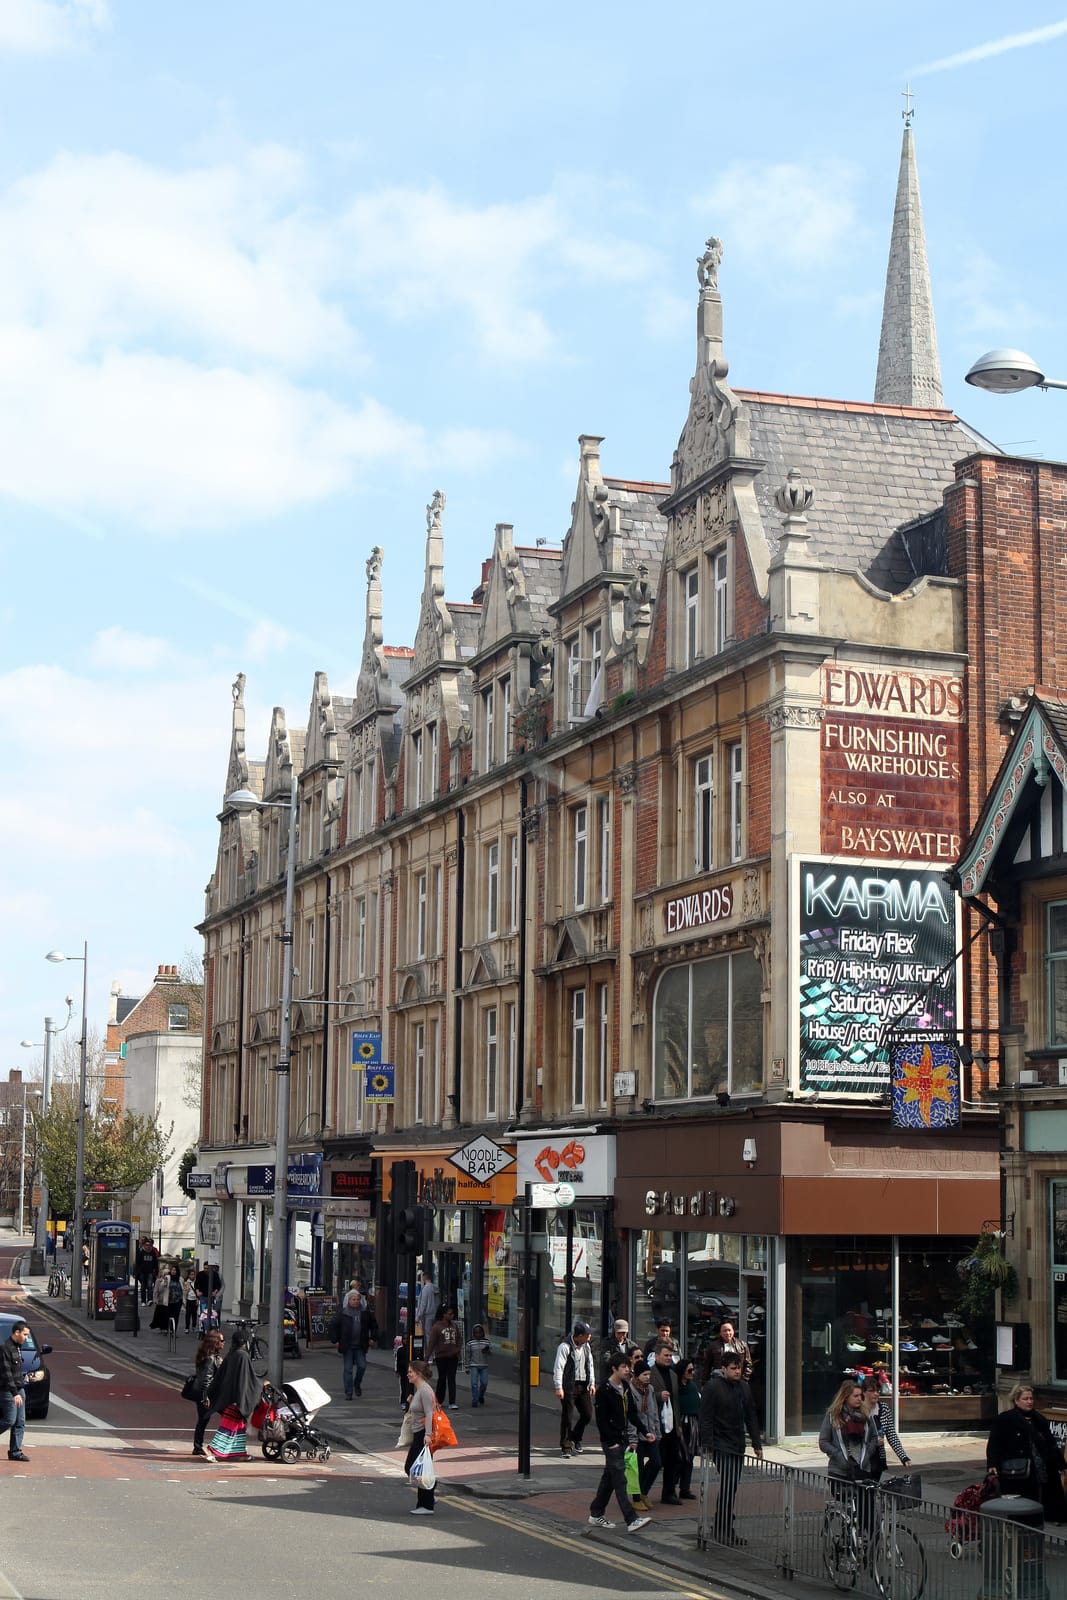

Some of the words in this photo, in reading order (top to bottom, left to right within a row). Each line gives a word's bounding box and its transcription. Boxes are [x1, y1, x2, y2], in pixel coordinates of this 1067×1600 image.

[824, 668, 965, 718] EDWARDS
[824, 724, 948, 758] FURNISHING
[844, 752, 961, 779] WAREHOUSES
[827, 789, 867, 805] ALSO
[876, 794, 896, 808] AT
[841, 826, 961, 857] BAYSWATER
[667, 886, 731, 933] EDWARDS
[806, 873, 950, 923] KARMA
[841, 930, 883, 958] Friday
[916, 964, 949, 988] Funky
[830, 991, 890, 1020] Saturday
[816, 1060, 840, 1074] High
[840, 1060, 867, 1073] Street
[461, 1149, 503, 1162] NOODLE
[468, 1161, 497, 1174] BAR
[458, 1180, 491, 1189] halfords
[645, 1190, 736, 1217] Studio
